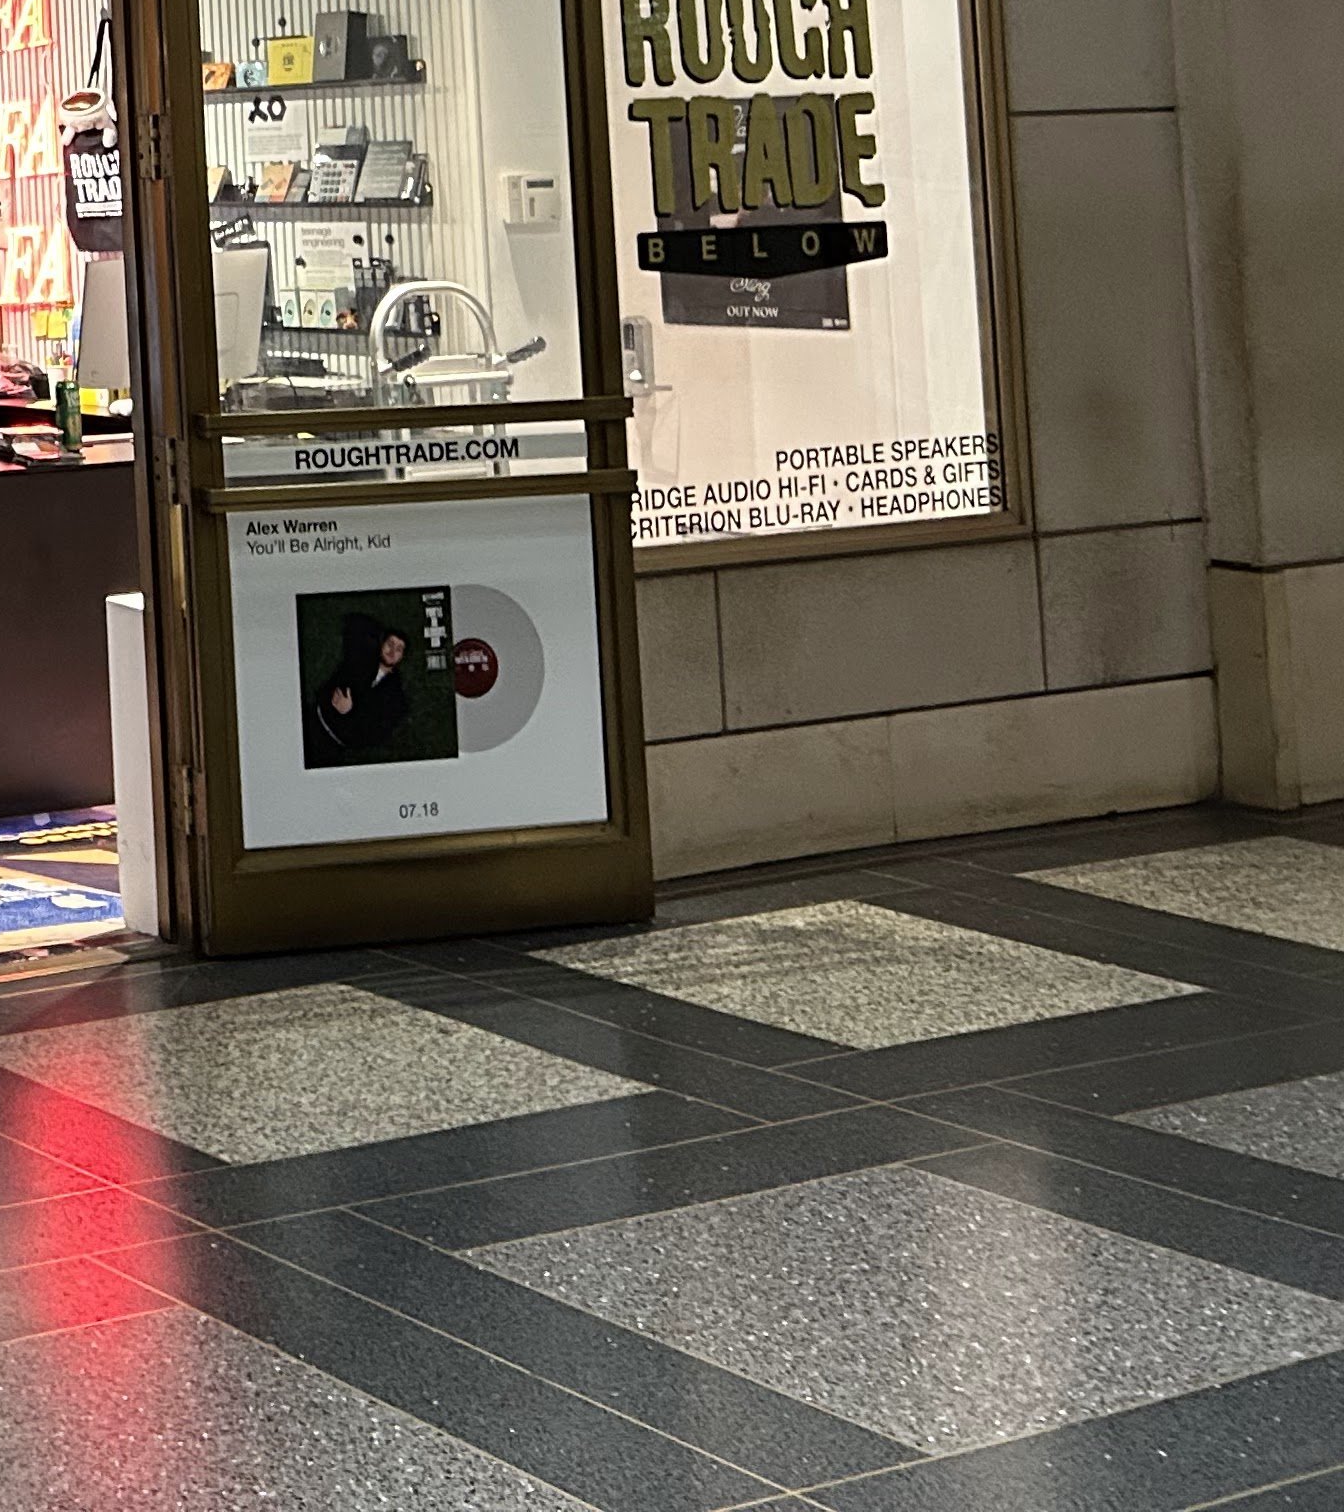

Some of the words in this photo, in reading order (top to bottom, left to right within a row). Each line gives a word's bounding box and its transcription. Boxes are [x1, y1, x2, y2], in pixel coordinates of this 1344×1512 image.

[628, 91, 886, 216] TRADE
[647, 228, 876, 264] BELOW
[726, 306, 751, 318] OUT
[752, 306, 779, 318] NOW
[294, 437, 520, 471] ROUGHTRADE.COM
[775, 439, 885, 472] PORTABLE
[891, 432, 999, 462] SPEAKERS
[703, 479, 772, 506] AUDIO
[778, 473, 827, 499] HI-FI
[845, 467, 919, 493] CARDS
[924, 465, 937, 485] &
[942, 459, 1000, 483] GIFTS
[749, 500, 841, 529] BLU-RAY
[861, 484, 1002, 519] HEADPHONES
[246, 521, 280, 536] Alex
[282, 518, 338, 535] Warren
[246, 537, 287, 556] You'll
[289, 538, 311, 553] Be
[313, 535, 363, 554] Alright,
[367, 534, 391, 550] Kid
[399, 801, 440, 819] 07.18
